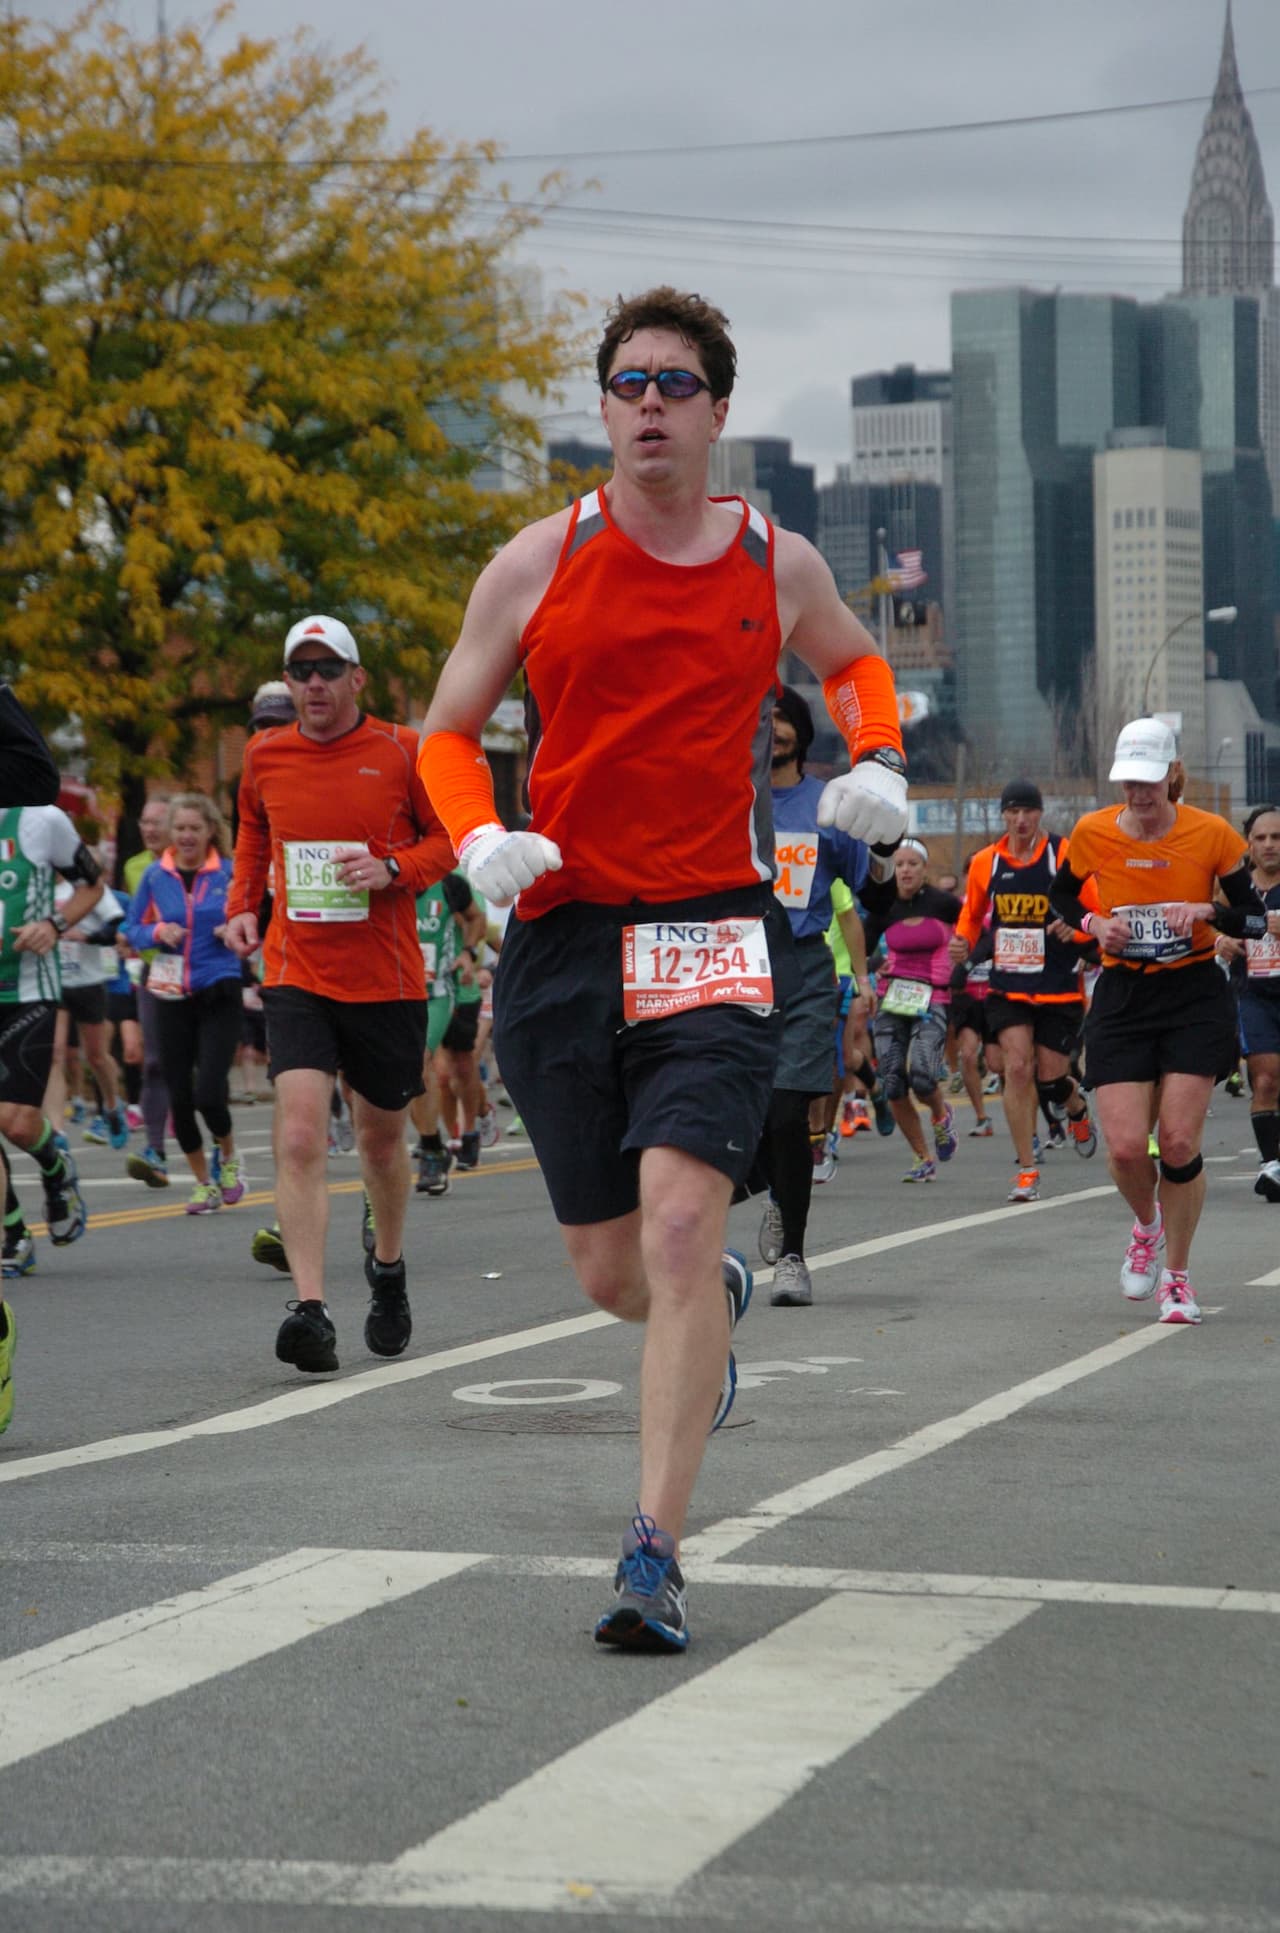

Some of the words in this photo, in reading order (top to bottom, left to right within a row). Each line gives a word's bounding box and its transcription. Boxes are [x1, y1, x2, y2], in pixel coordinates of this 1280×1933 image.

[298, 848, 330, 860] ING
[773, 843, 817, 867] ace
[995, 894, 1050, 915] NYPD
[1128, 908, 1159, 919] ING
[656, 925, 708, 943] ING
[625, 943, 634, 974] WAVE
[650, 946, 750, 984] 12-254
[636, 991, 700, 1009] MARATHON
